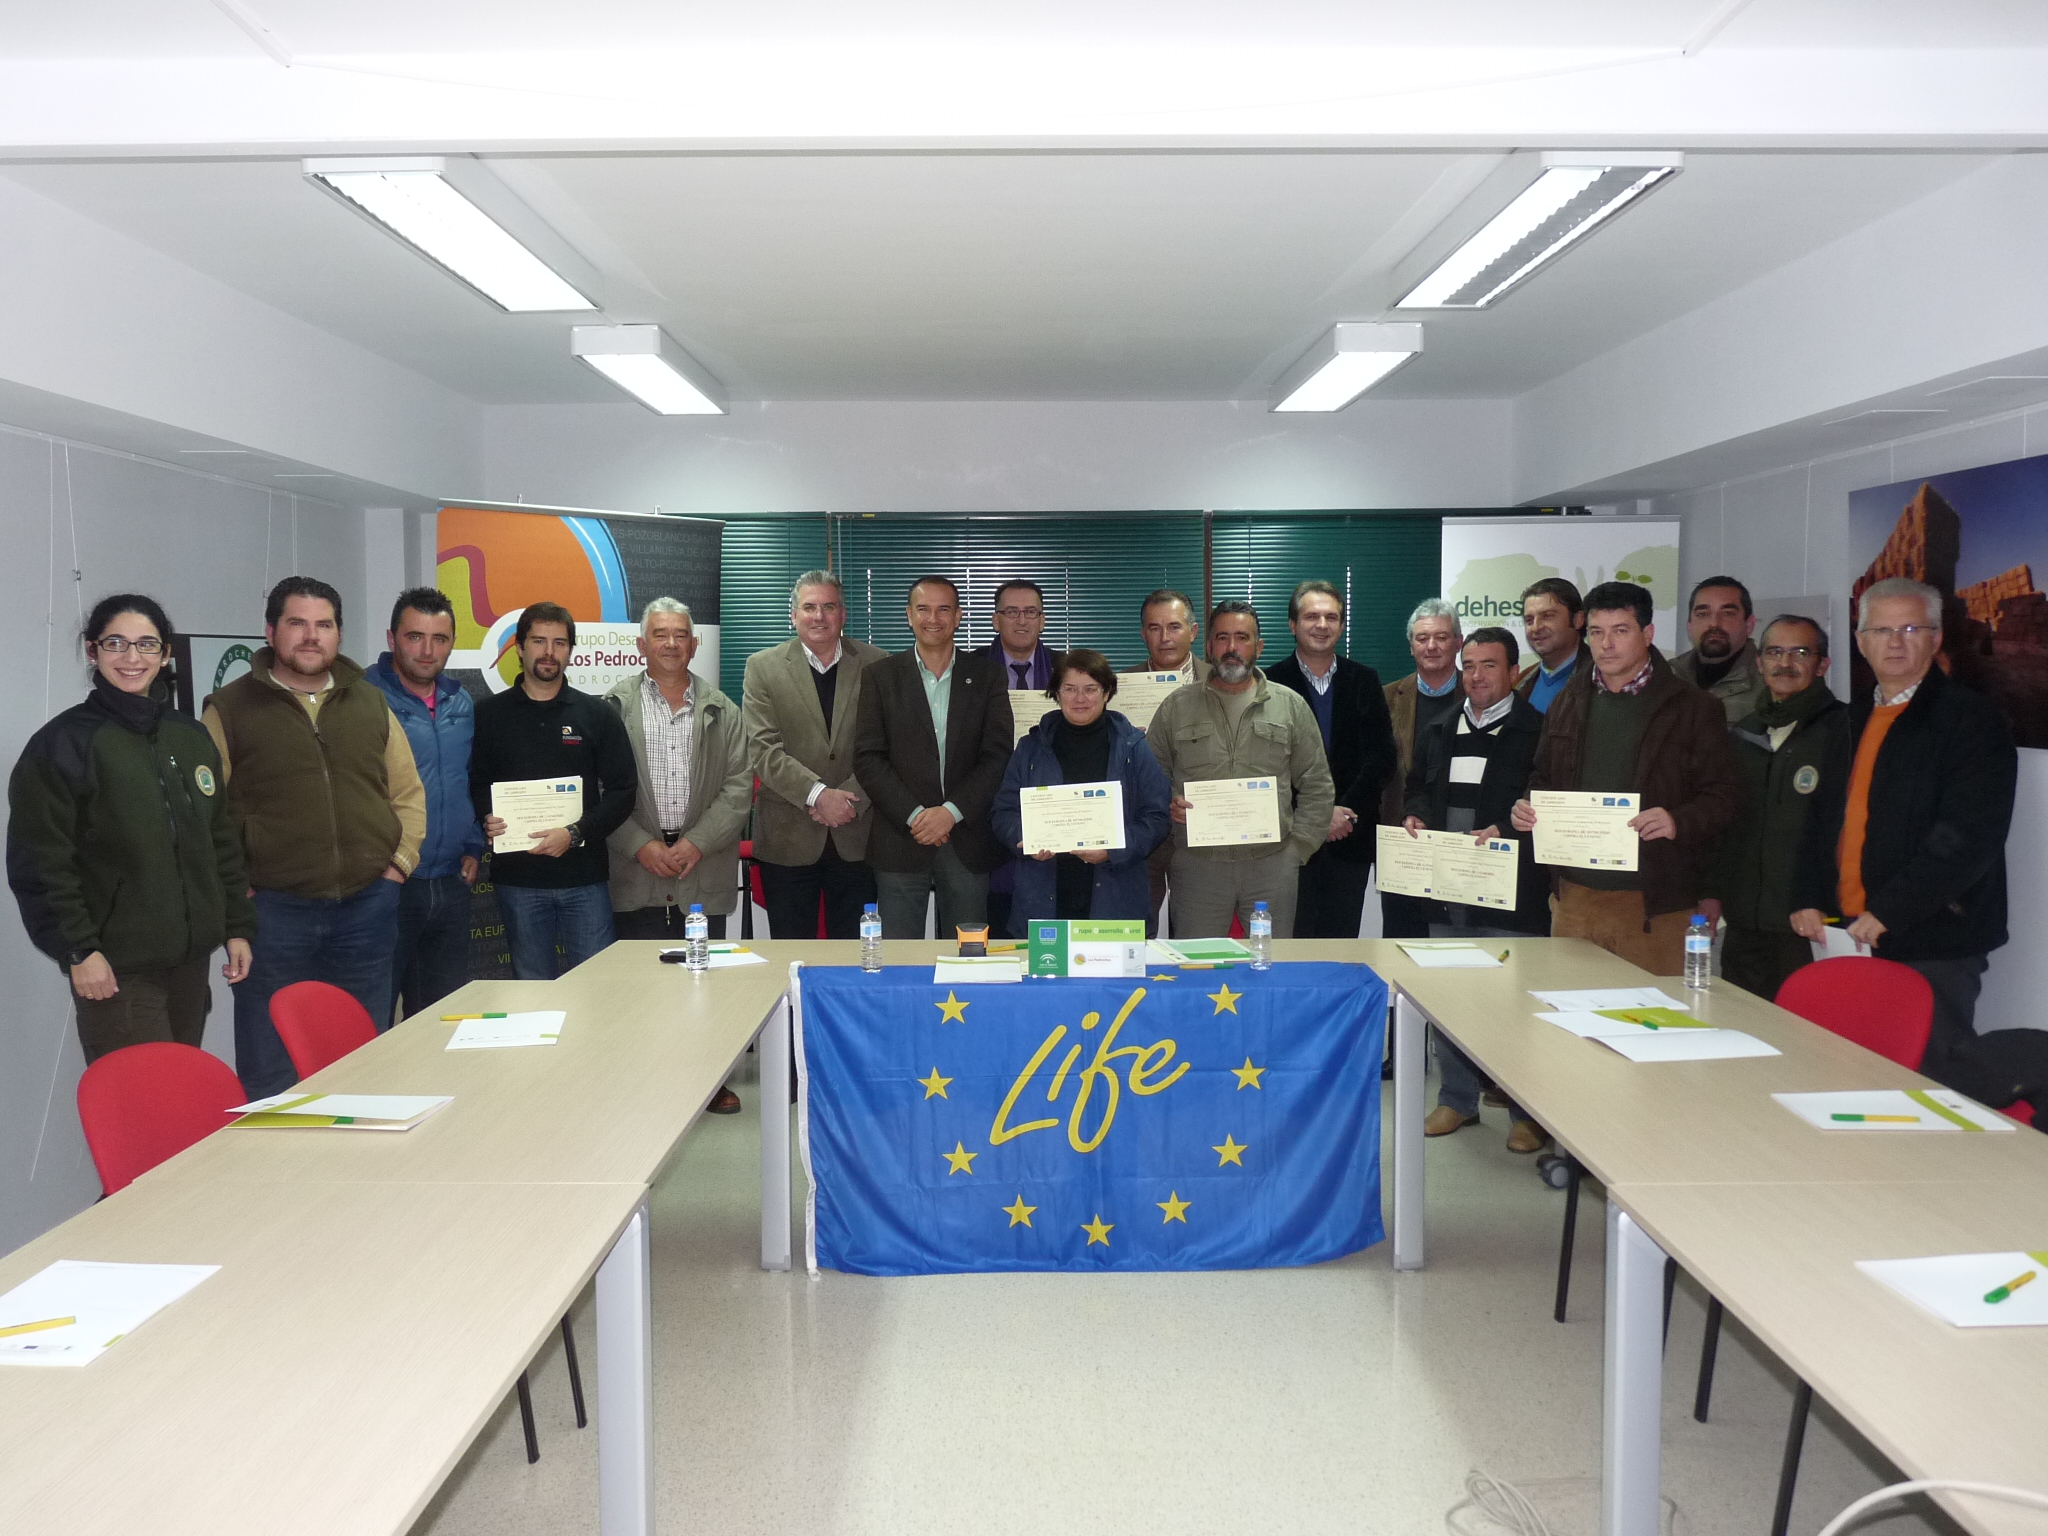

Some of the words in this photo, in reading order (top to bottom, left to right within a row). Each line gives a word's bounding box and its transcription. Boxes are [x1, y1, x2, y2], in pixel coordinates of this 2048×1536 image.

[1455, 595, 1524, 617] dehes
[1459, 619, 1509, 628] ONSERVACIÓN
[575, 633, 606, 649] rupo
[609, 632, 637, 646] Desa
[595, 650, 646, 667] Pedroc
[989, 987, 1191, 1153] Life
